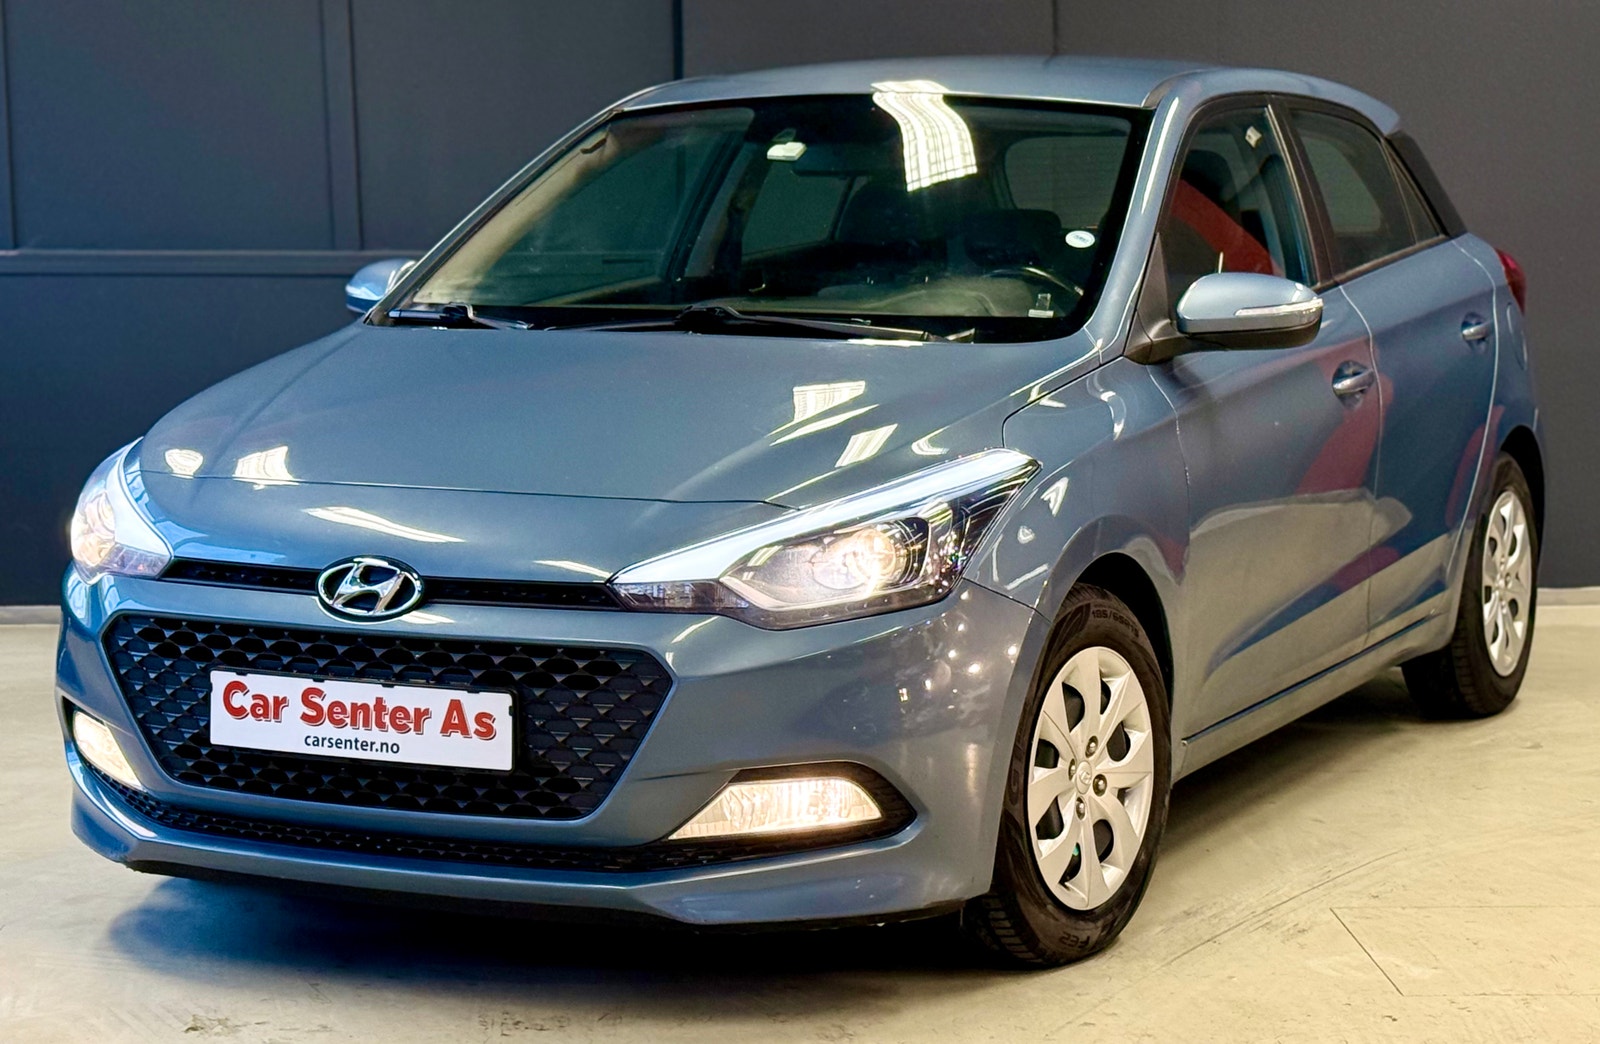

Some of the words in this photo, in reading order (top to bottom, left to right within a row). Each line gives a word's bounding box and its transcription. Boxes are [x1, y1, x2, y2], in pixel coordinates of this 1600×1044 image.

[222, 680, 289, 723] Car
[300, 686, 432, 734] Senter
[439, 698, 498, 741] As
[303, 733, 401, 755] carsenter.no
